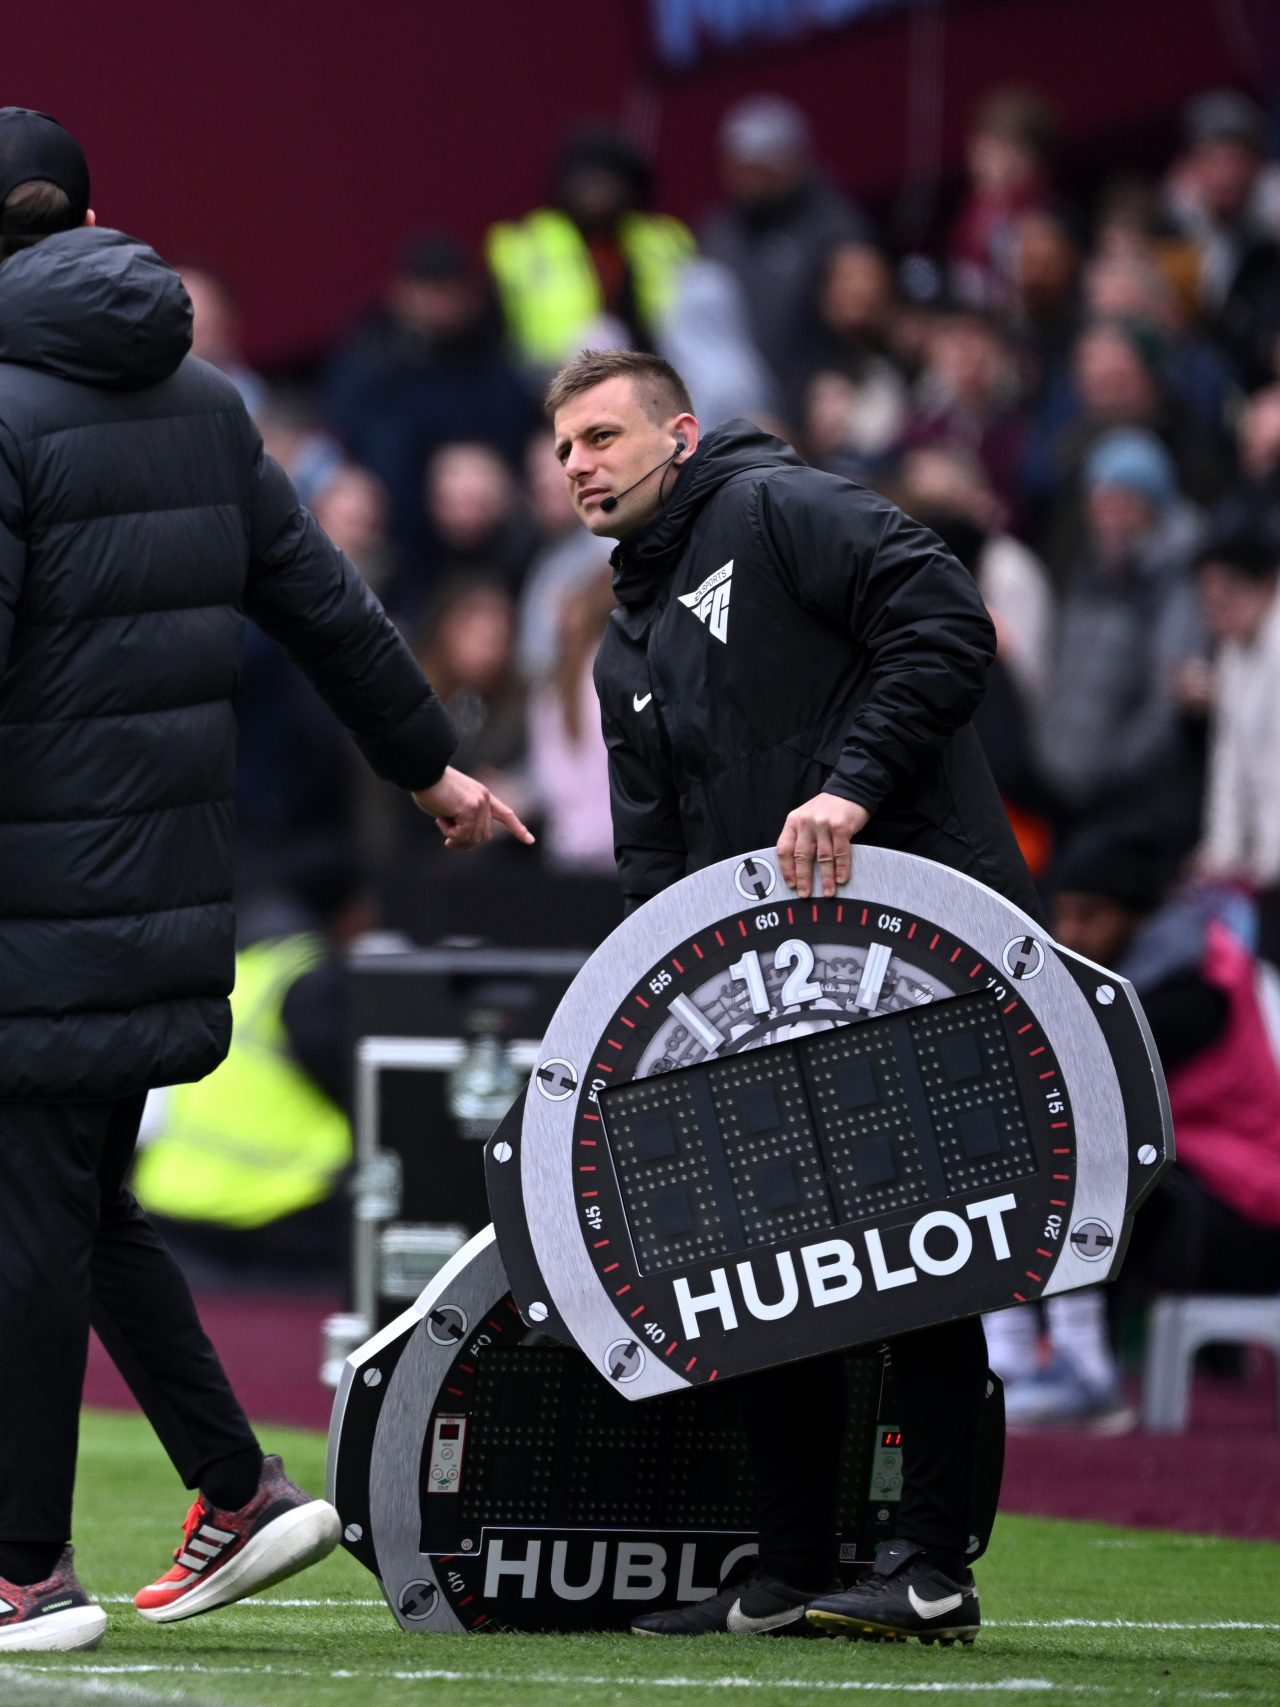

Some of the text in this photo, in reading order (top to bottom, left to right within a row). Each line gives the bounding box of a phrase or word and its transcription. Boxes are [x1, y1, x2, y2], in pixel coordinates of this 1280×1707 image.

[701, 569, 727, 593] SPORTS
[755, 911, 780, 930] 60
[877, 913, 902, 933] 05
[649, 969, 673, 995] 55
[729, 938, 823, 1015] 12
[1046, 1088, 1065, 1114] 15
[585, 1205, 603, 1230] 45
[1043, 1214, 1063, 1241] 20
[672, 1193, 1018, 1341] HUBLOT
[643, 1322, 667, 1344] 40
[447, 1571, 465, 1592] 40
[483, 1539, 759, 1602] HUBL
